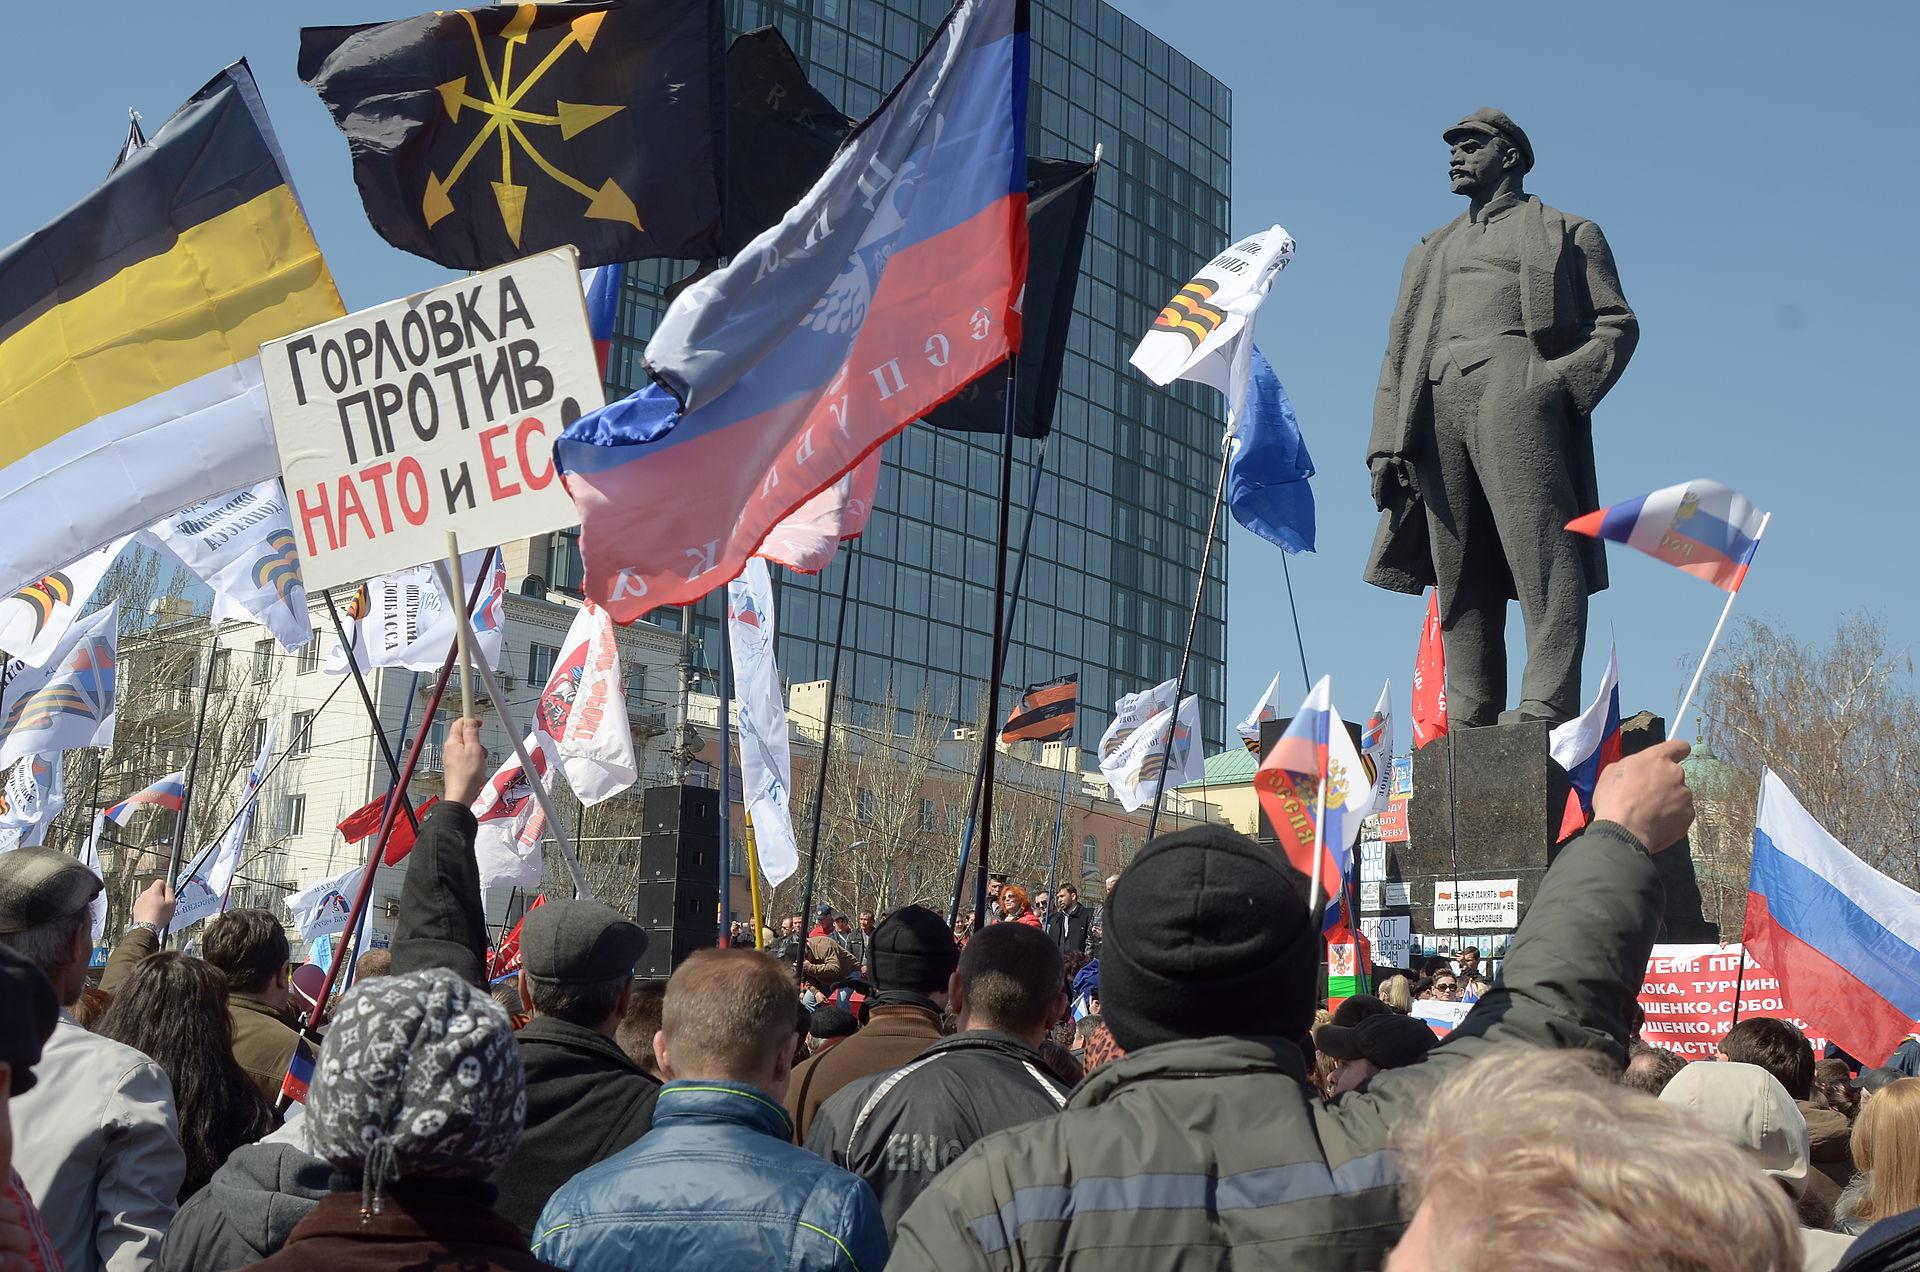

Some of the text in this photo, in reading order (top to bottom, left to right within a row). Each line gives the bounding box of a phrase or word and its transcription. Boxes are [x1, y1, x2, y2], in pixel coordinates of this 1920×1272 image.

[286, 275, 535, 405] ГОРЛОВКА
[336, 338, 555, 465] ПРОТИВ
[296, 456, 429, 557] НАТО
[382, 580, 399, 651] ДОНБАССА
[1267, 768, 1316, 846] ОССИЯ
[1361, 828, 1404, 840] ГУБАРЕВУ
[1475, 889, 1497, 900] ПАМЯТЬ
[1468, 902, 1501, 911] БЕРКУТЯТАМ
[1363, 918, 1398, 938] ОЙКОТ
[1464, 914, 1503, 925] БАНДЕРОВЦЕВ
[1371, 951, 1399, 961] БОРАМ
[1709, 955, 1761, 972] ПРИ
[1640, 982, 1686, 997] ЮКА,
